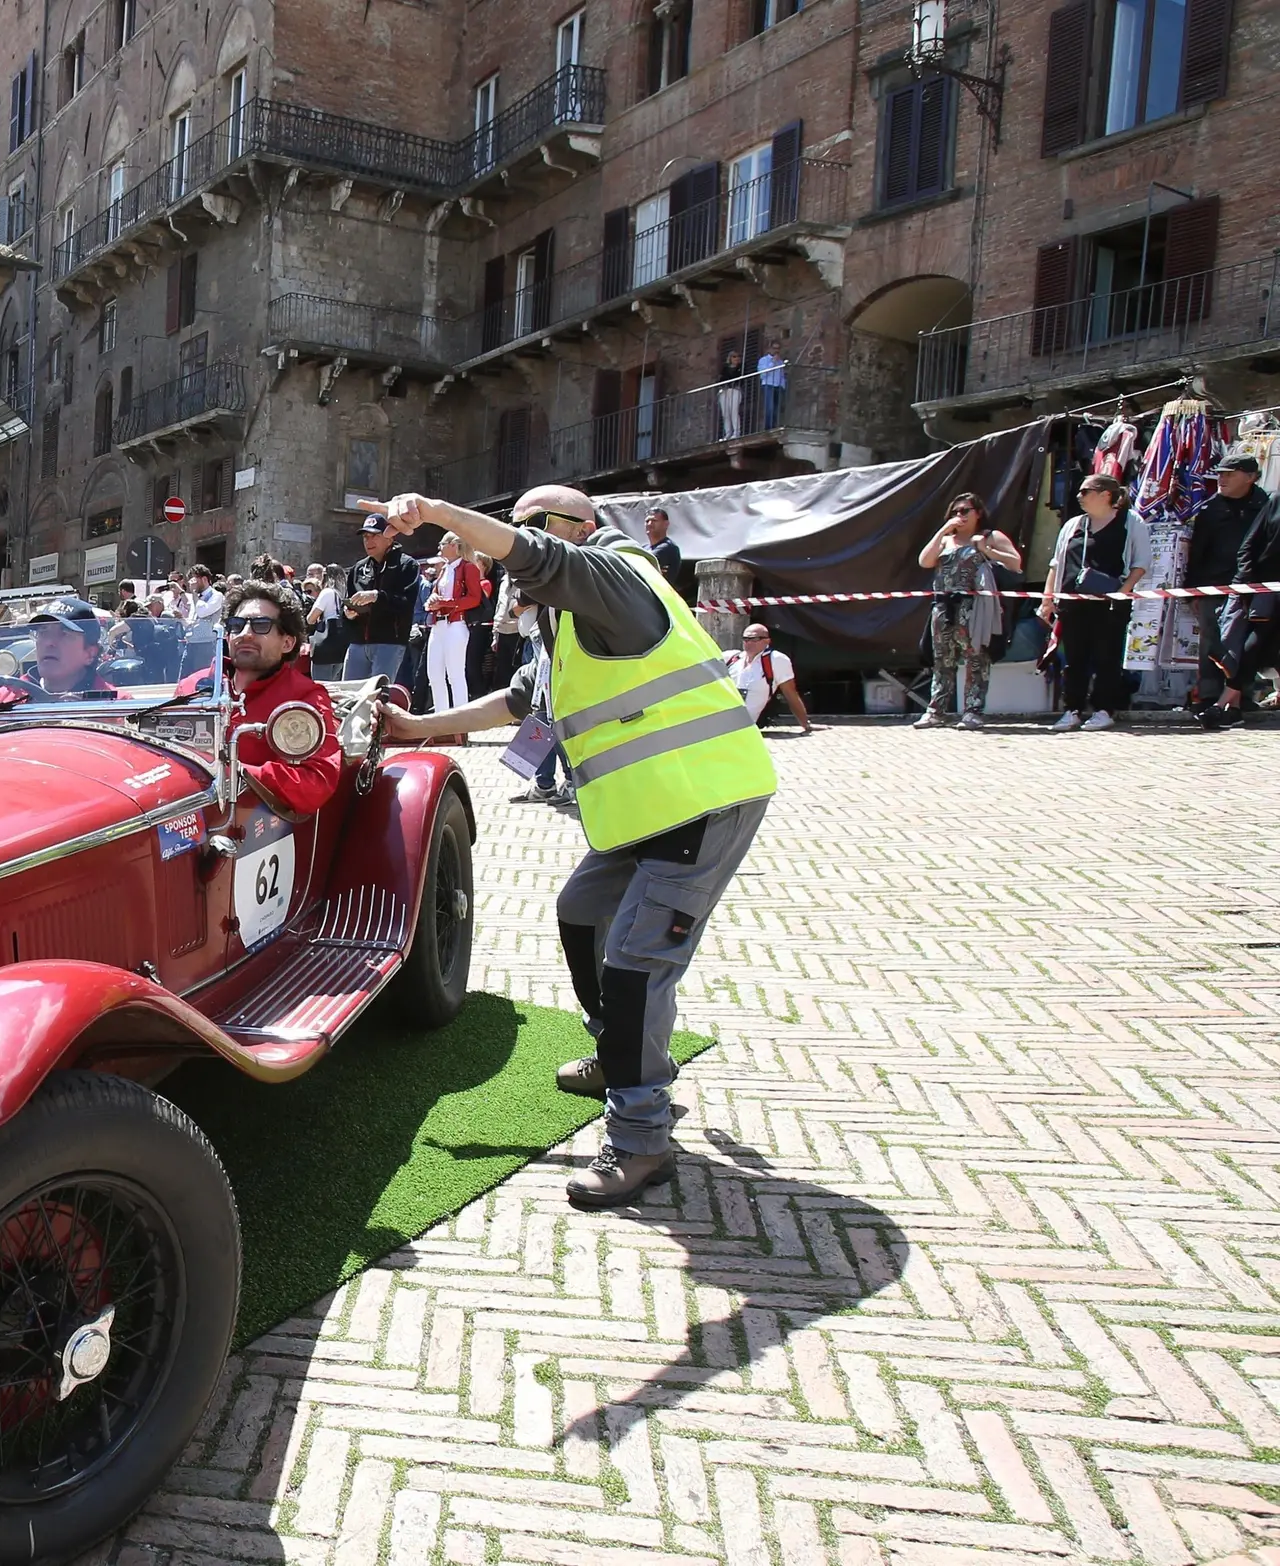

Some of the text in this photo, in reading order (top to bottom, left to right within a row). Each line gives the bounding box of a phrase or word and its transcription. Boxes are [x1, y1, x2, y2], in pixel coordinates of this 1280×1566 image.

[87, 564, 115, 577] VALLEVERDE
[164, 813, 198, 834] SPONSOR
[179, 826, 200, 840] TEAM
[255, 853, 280, 906] 62
